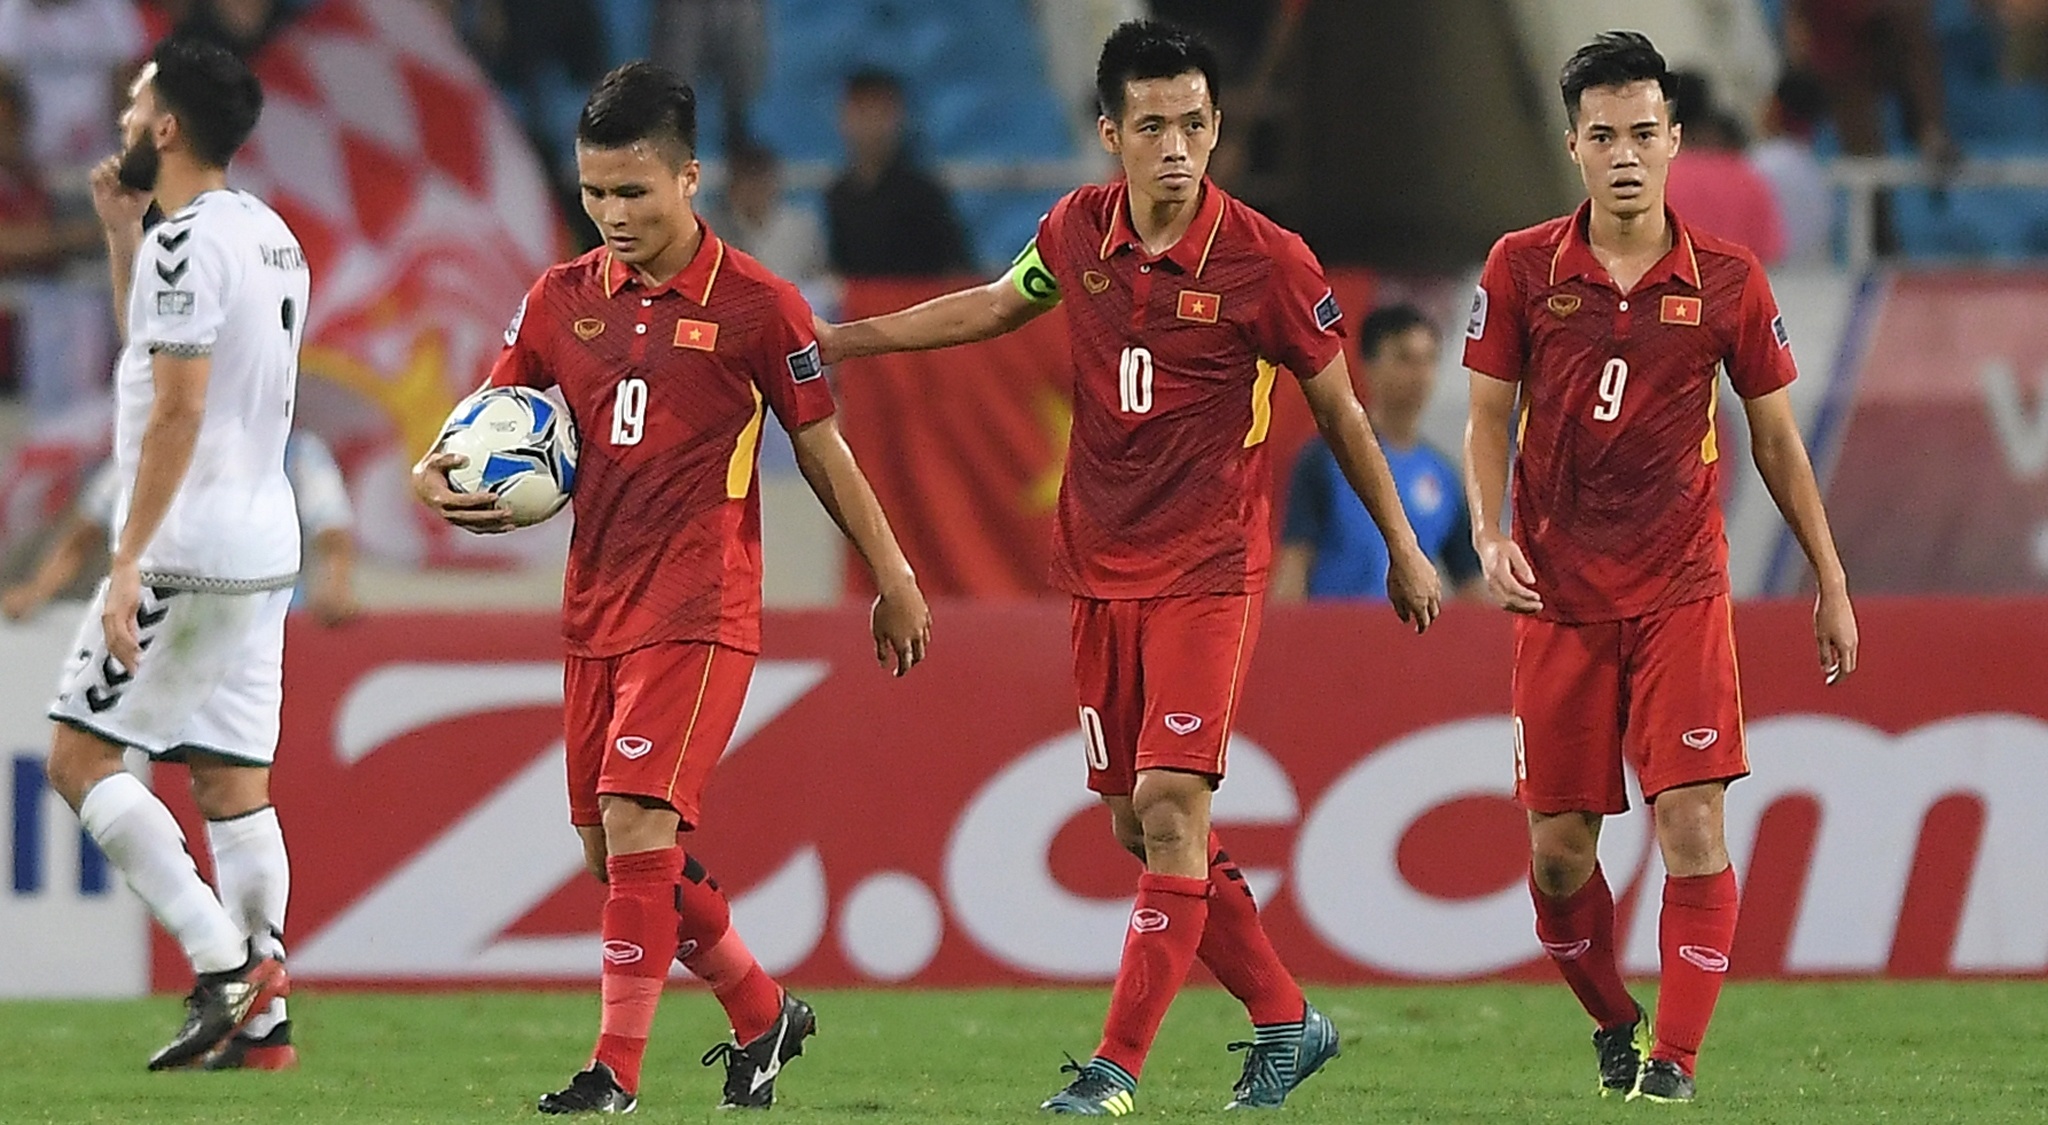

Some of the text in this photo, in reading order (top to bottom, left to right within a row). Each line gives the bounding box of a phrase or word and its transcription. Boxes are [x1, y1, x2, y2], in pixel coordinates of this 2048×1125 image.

[610, 378, 648, 446] 19
[1119, 346, 1153, 414] 10
[1593, 358, 1628, 422] 9
[285, 663, 2048, 980] Z.com
